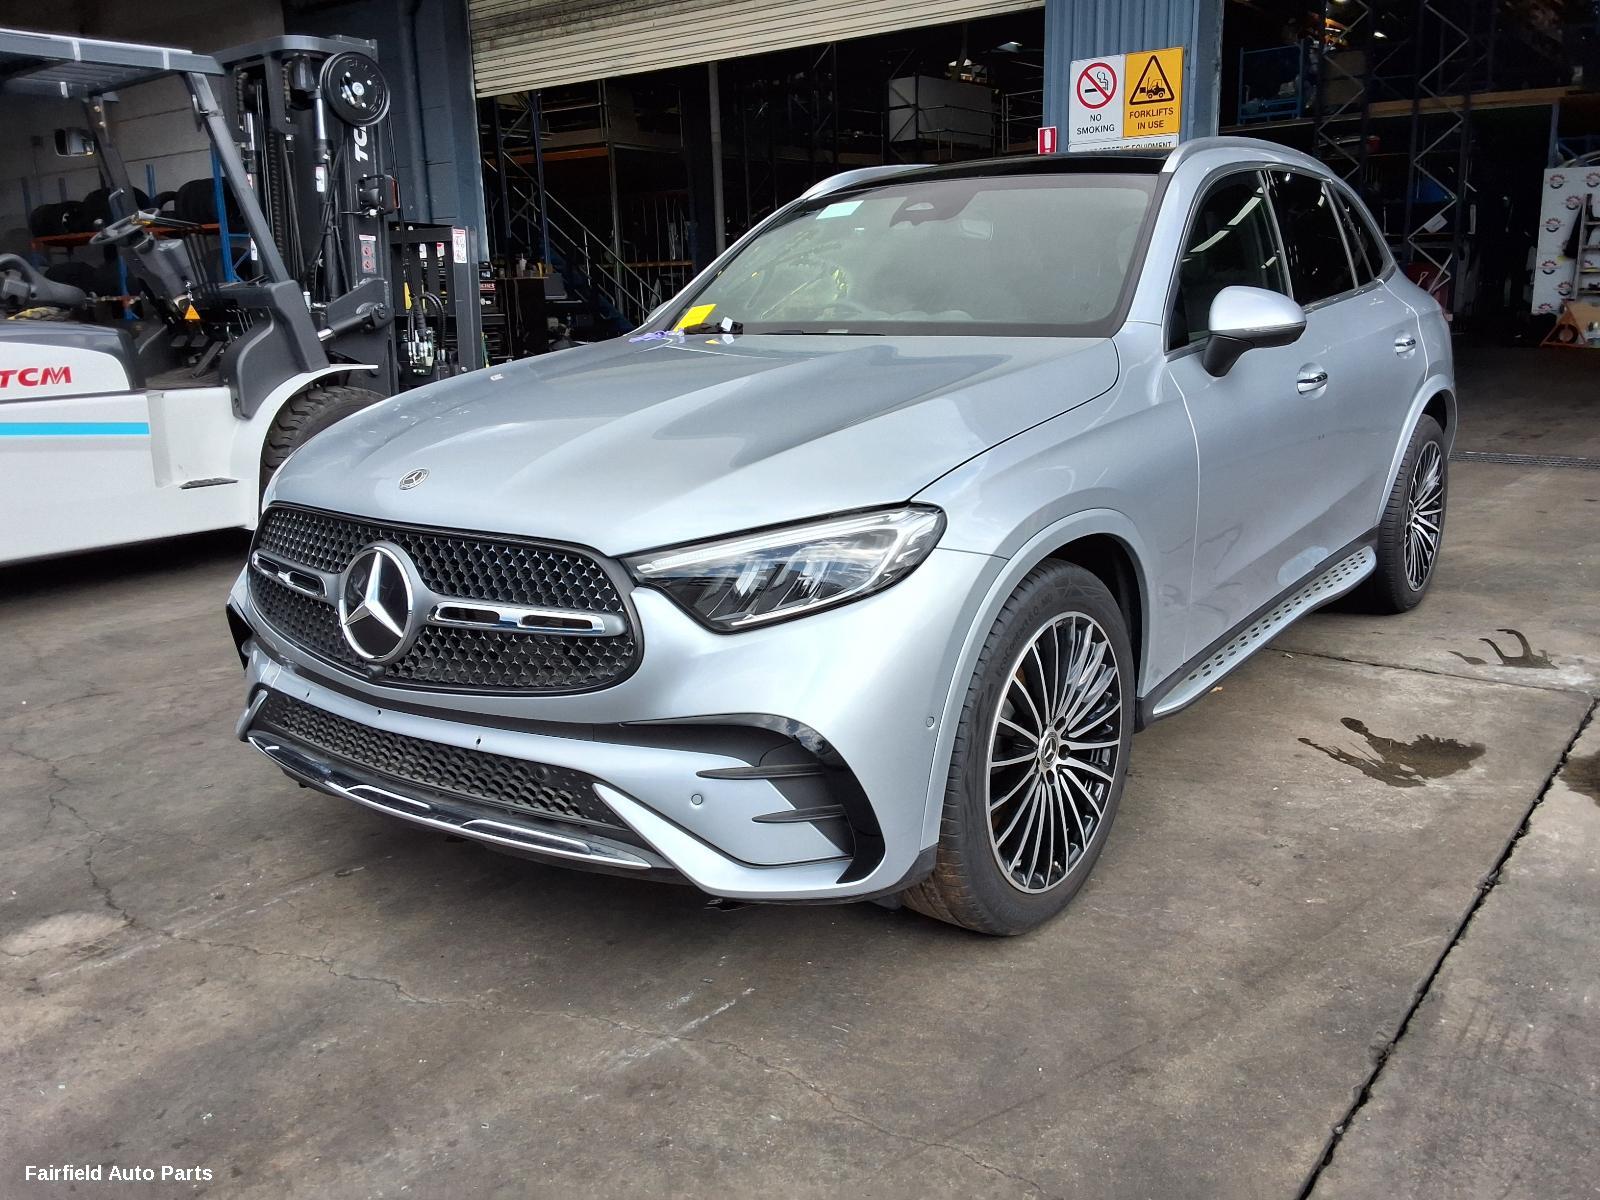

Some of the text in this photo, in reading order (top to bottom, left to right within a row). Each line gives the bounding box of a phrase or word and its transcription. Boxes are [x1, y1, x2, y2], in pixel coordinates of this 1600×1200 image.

[1089, 113, 1102, 122] NO
[1129, 106, 1174, 119] FORKLIFTS
[1076, 123, 1115, 135] SMOKING
[1137, 120, 1164, 130] IN USE
[353, 126, 369, 162] TC
[0, 366, 72, 388] TCM
